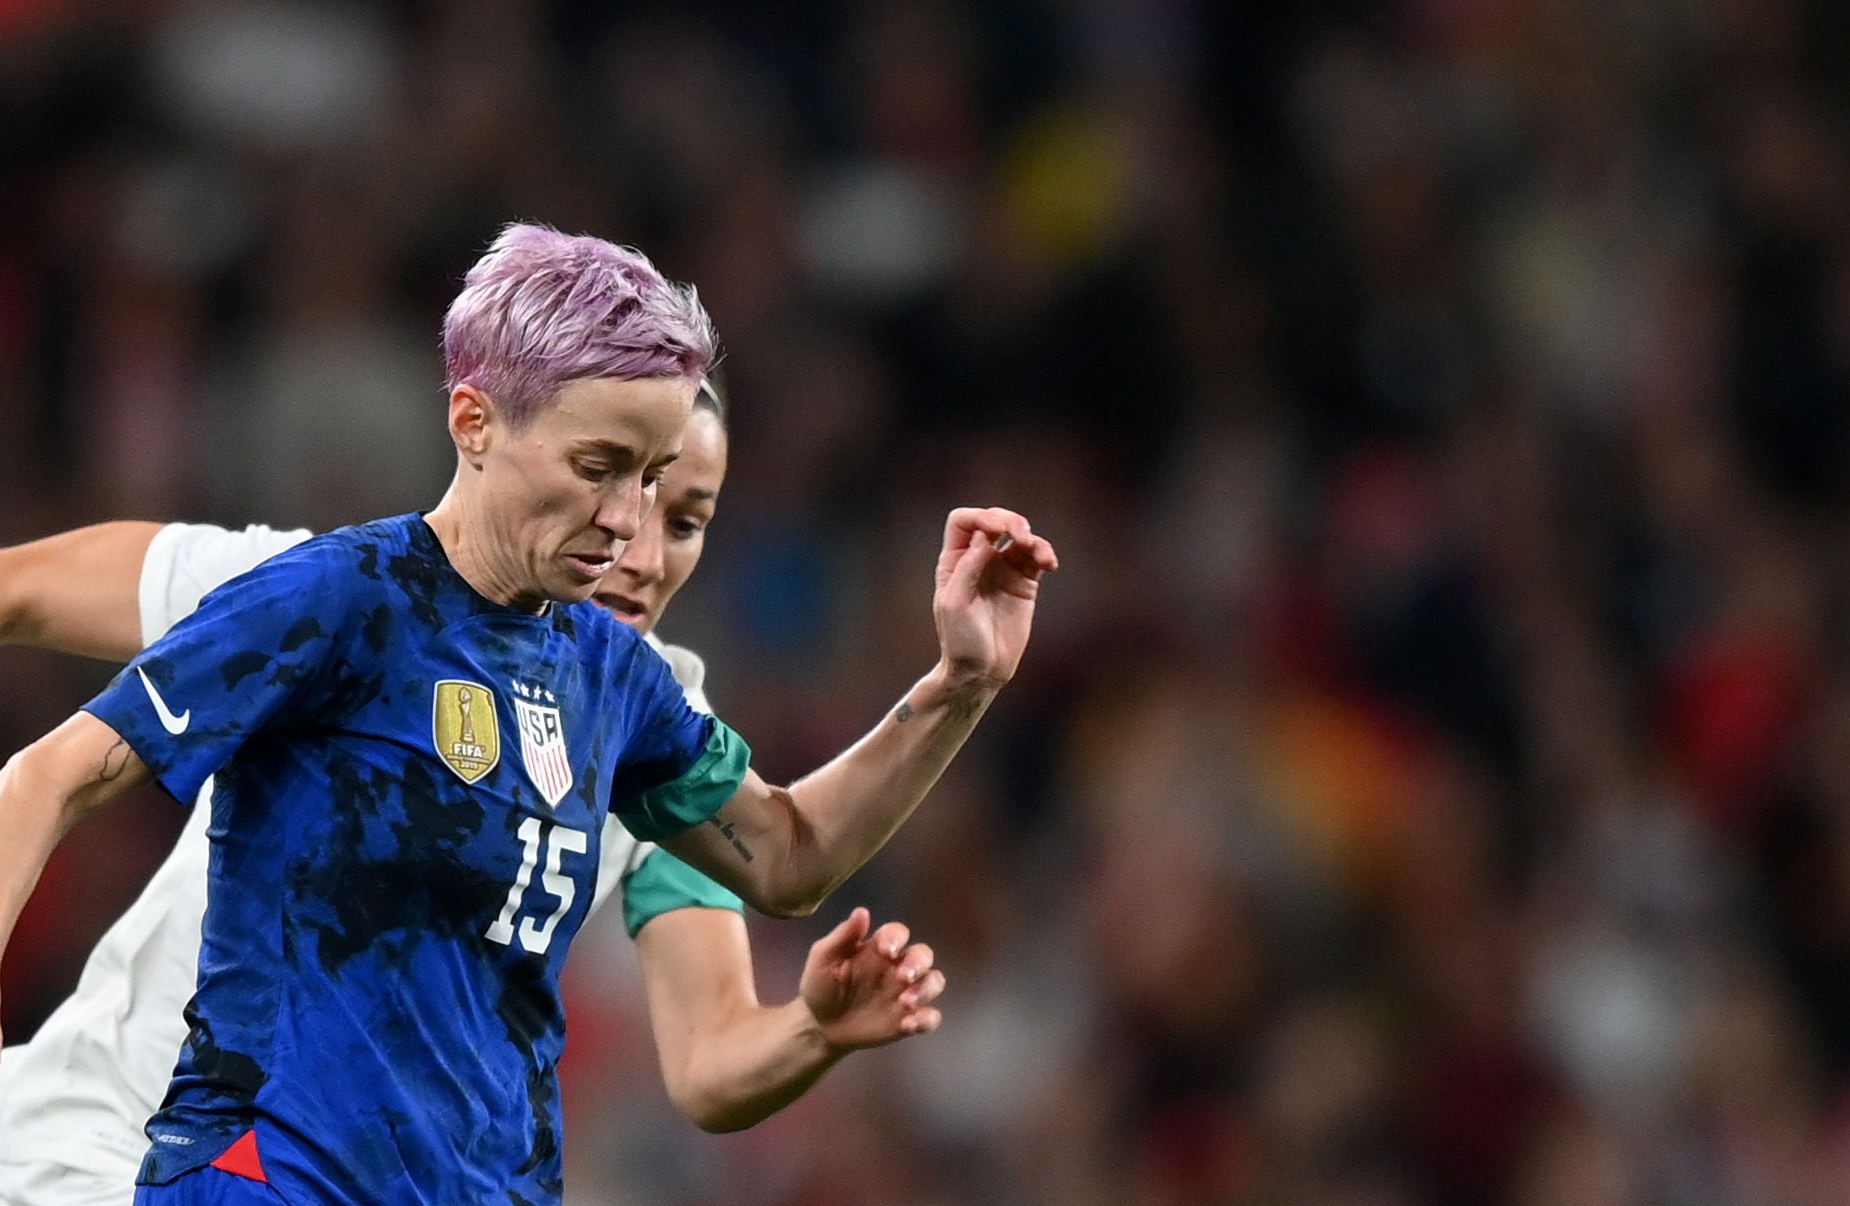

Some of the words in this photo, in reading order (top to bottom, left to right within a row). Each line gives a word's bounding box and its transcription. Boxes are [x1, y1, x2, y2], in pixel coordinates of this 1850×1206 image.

[517, 704, 559, 747] USA
[453, 742, 483, 758] FIFA
[484, 817, 587, 955] 15
